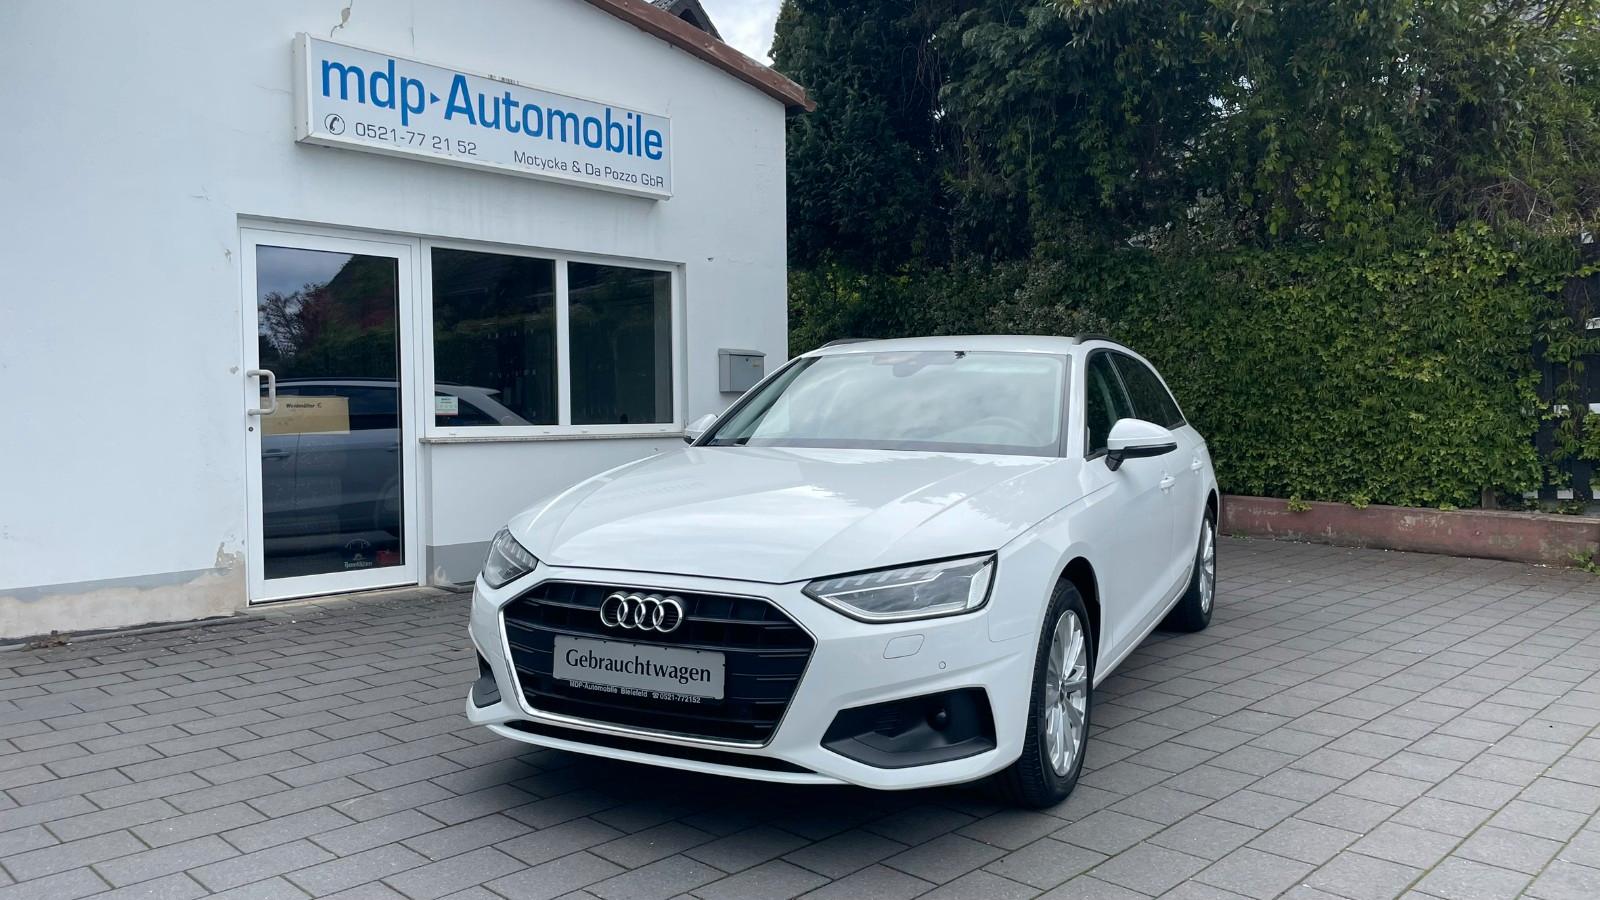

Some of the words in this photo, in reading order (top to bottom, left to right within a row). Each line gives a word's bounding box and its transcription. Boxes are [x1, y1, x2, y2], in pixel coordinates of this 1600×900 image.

[444, 74, 663, 161] Automobile
[355, 122, 426, 146] 0521-77
[432, 135, 450, 151] 21
[457, 140, 477, 156] 52
[514, 150, 568, 170] Motycka
[572, 160, 582, 173] &
[585, 163, 601, 177] Da
[604, 166, 638, 183] Pozzo
[641, 173, 664, 188] GbR
[565, 649, 711, 685] Gebrauchtwagen
[569, 679, 618, 695] MDP-Automobile
[620, 687, 648, 698] Bielefeld
